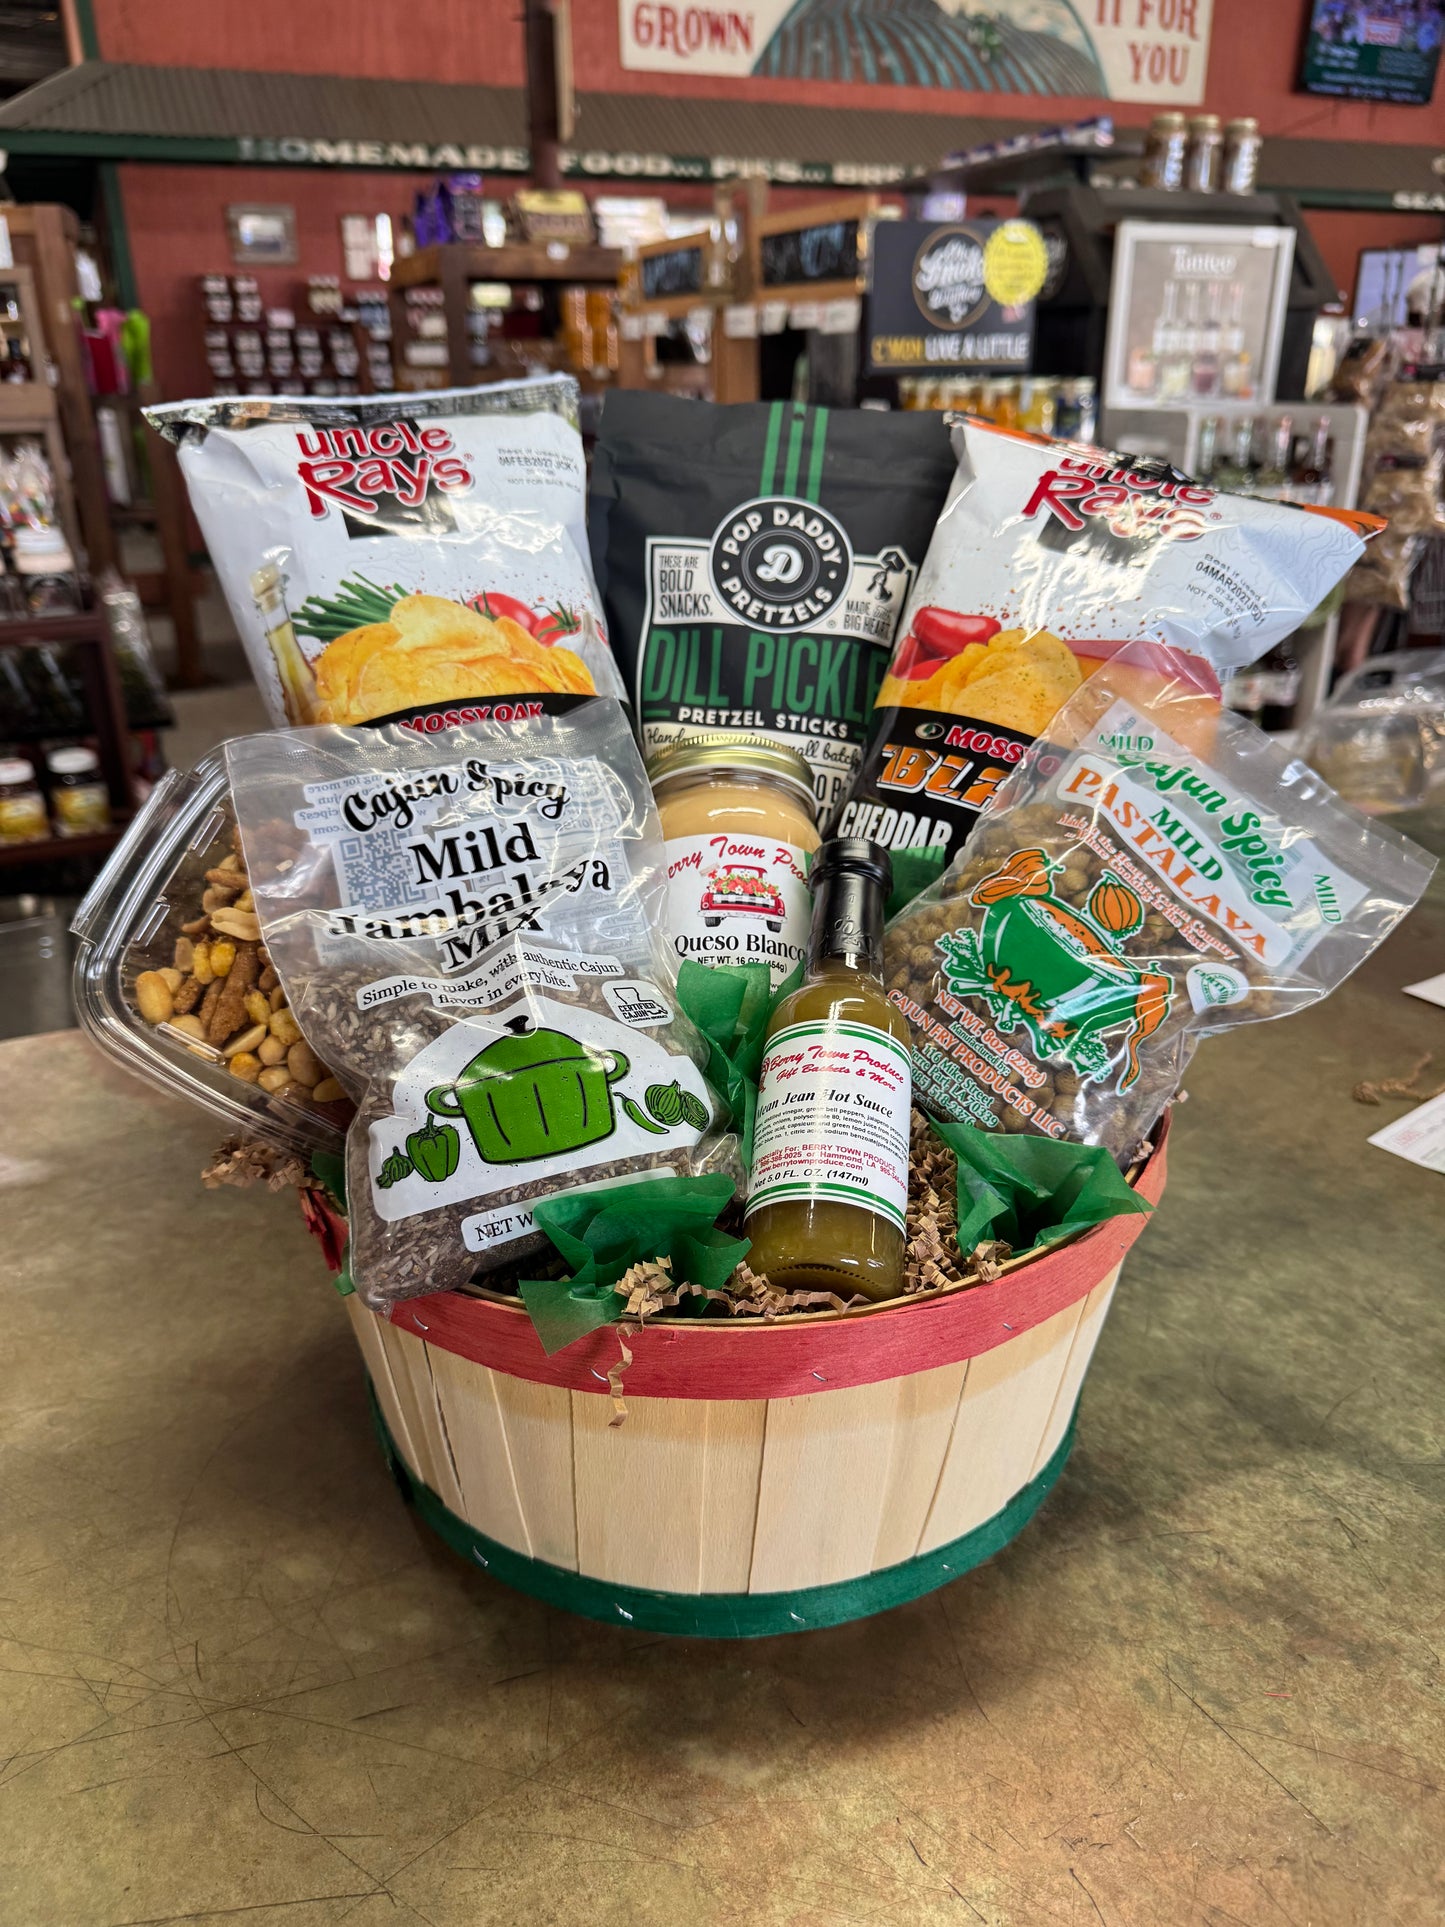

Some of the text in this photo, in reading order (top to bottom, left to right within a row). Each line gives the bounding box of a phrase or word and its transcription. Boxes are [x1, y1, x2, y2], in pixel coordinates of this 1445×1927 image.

[633, 2, 754, 58] GROWN
[1137, 0, 1199, 41] FOR
[1128, 41, 1189, 86] YOU
[238, 136, 531, 171] HOMEMADE
[296, 421, 453, 460] uncle
[721, 506, 842, 564] POP DADDY
[659, 569, 694, 593] BOLD
[721, 576, 832, 624] PRETZELS
[659, 593, 713, 618] SNACKS.
[843, 614, 861, 631] BIG
[642, 628, 730, 707] DILL
[399, 701, 545, 733] MOSSY OAK
[677, 706, 848, 738] PRETZEL STICKS
[1098, 733, 1154, 752] MILD
[343, 771, 460, 833] Cajun
[465, 759, 571, 820] Spicy
[837, 799, 953, 852] CHEDDAR
[1116, 753, 1228, 814] Cajun
[1220, 811, 1294, 910] Spicy
[1149, 805, 1224, 882] MILD
[407, 821, 542, 885] Mild
[667, 850, 704, 879] erry
[709, 835, 766, 859] Town
[1064, 766, 1267, 959] PASTALAYA
[327, 858, 612, 941] Jambalaya
[1107, 856, 1154, 902] Cooking
[1312, 873, 1343, 923] MILD
[1113, 849, 1148, 883] Heart
[1155, 891, 1192, 923] Cajun
[1189, 917, 1241, 960] Country
[440, 905, 545, 970] Mix
[674, 933, 806, 962] Queso Blanco
[362, 951, 620, 1006] Simple to make, with authentic Cajun
[697, 956, 715, 964] NET
[716, 956, 733, 965] WT.
[735, 957, 746, 965] 16
[438, 967, 571, 1006] flavor in every bite.
[934, 991, 961, 1019] NET
[960, 1010, 985, 1037] WT.
[1004, 1048, 1048, 1089] (226g)
[950, 1021, 1011, 1078] Manufactured by:
[770, 1045, 905, 1084] Berry Town Produce
[775, 1066, 799, 1083] Gift
[855, 1068, 866, 1077] &
[868, 1071, 897, 1092] More
[888, 989, 935, 1033] CAJUN
[930, 1021, 957, 1053] FRY
[951, 1042, 1034, 1118] PRODUCTS
[1030, 1109, 1067, 1140] LLC
[911, 1046, 931, 1071] erre
[949, 1082, 968, 1103] LA
[964, 1094, 999, 1128] 70339
[922, 1043, 943, 1064] 116
[940, 1056, 964, 1083] Mike
[961, 1076, 995, 1108] Street
[782, 1091, 816, 1106] Jean
[823, 1088, 851, 1103] Hot
[853, 1093, 893, 1119] Sauce
[911, 1066, 932, 1091] 985)
[927, 1083, 977, 1128] 518-2376
[824, 1128, 849, 1136] sodium
[831, 1121, 851, 1129] green
[784, 1145, 800, 1153] For:
[801, 1143, 833, 1151] BERRY
[835, 1144, 862, 1158] TOWN
[819, 1151, 865, 1166] Hammond,
[865, 1160, 877, 1169] LA
[753, 1176, 767, 1191] Net
[767, 1171, 781, 1184] 5.0
[782, 1168, 800, 1179] FL.
[826, 1168, 870, 1187] (147ml)
[474, 1211, 534, 1242] NET W
